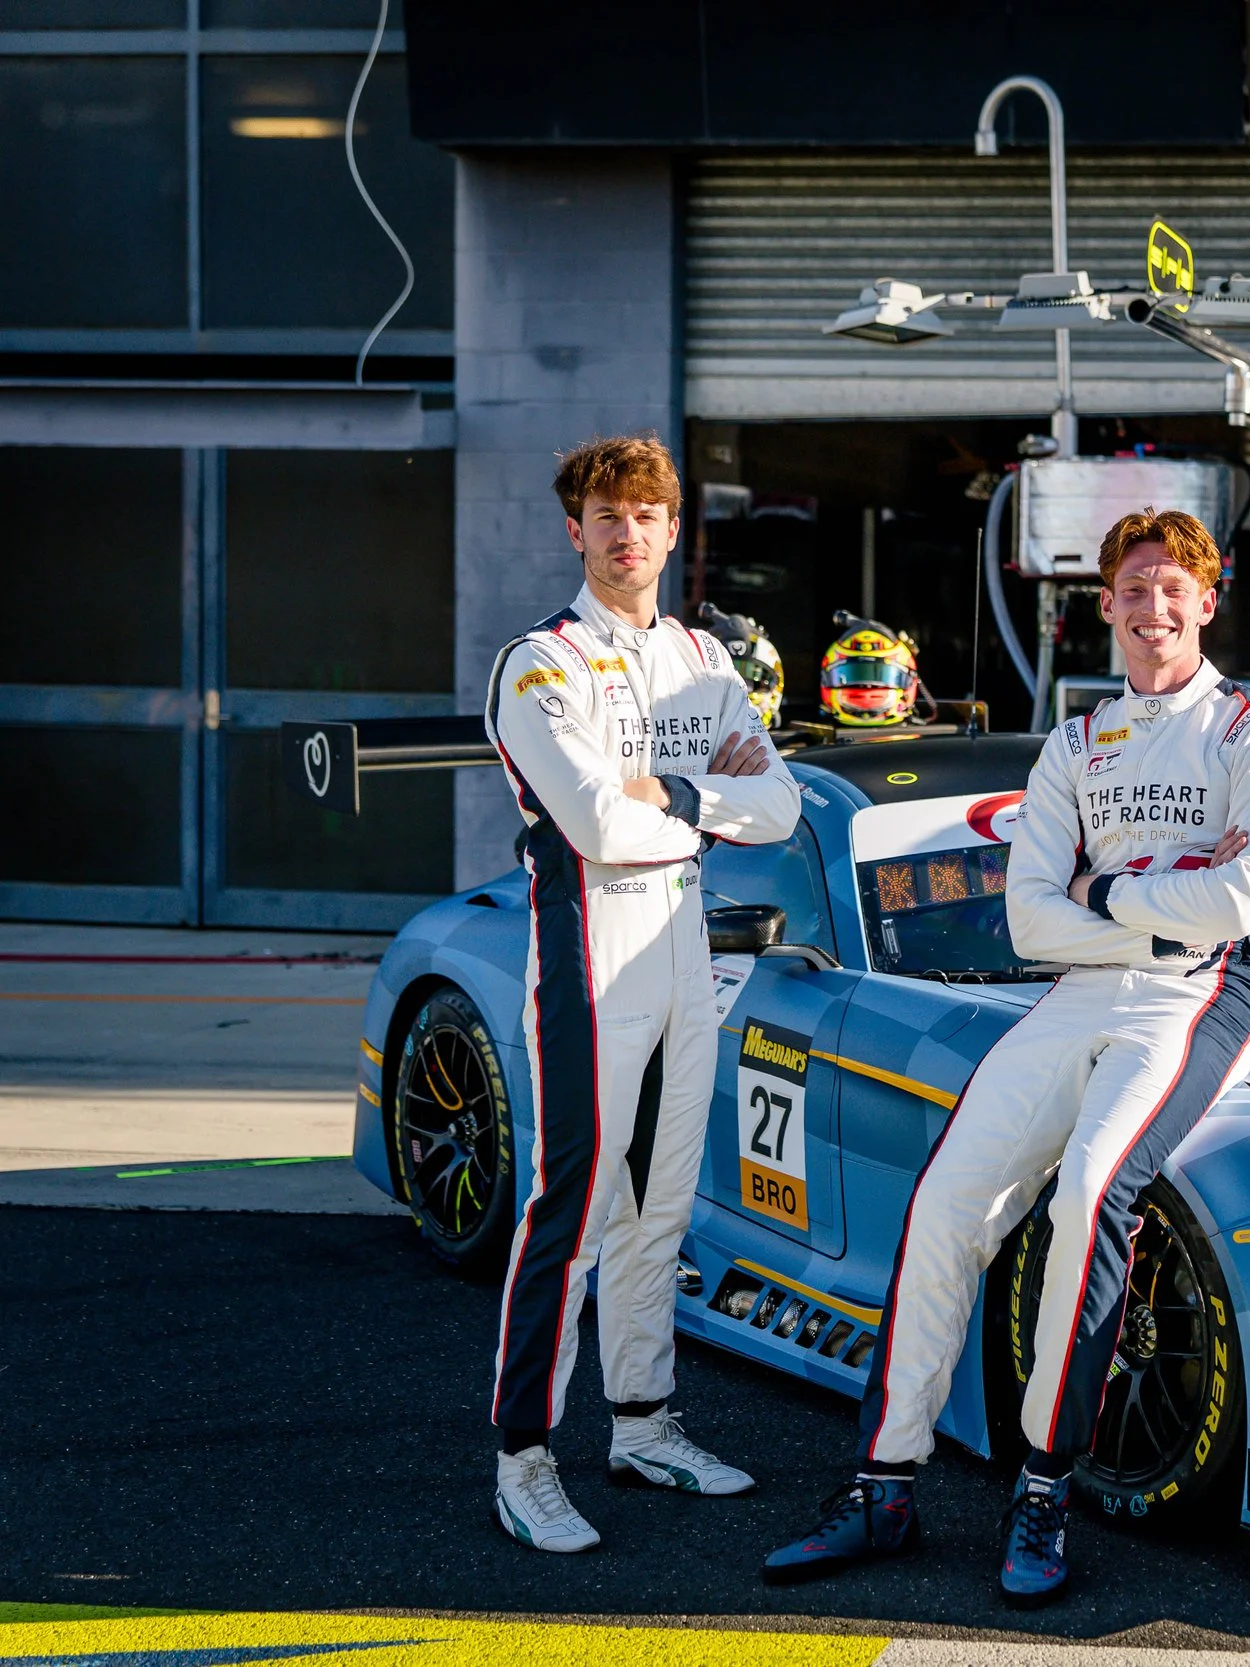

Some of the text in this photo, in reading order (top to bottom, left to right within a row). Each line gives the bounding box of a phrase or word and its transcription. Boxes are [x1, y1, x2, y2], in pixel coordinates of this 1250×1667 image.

[619, 717, 712, 737] THE HEART
[1065, 722, 1082, 757] sparco
[622, 739, 710, 759] OF RACNG
[1088, 784, 1208, 809] THE HEART
[1091, 805, 1205, 830] OF RACING
[1125, 830, 1144, 842] THE
[1150, 830, 1188, 843] DRIVE
[602, 882, 647, 895] sparco
[744, 1025, 807, 1074] MEGUIAR'S
[473, 1025, 510, 1161] PIRELLI
[751, 1085, 793, 1162] 27
[752, 1173, 796, 1215] BRO
[1011, 1231, 1029, 1384] PIRELLI
[1195, 1294, 1228, 1466] P ZERO
